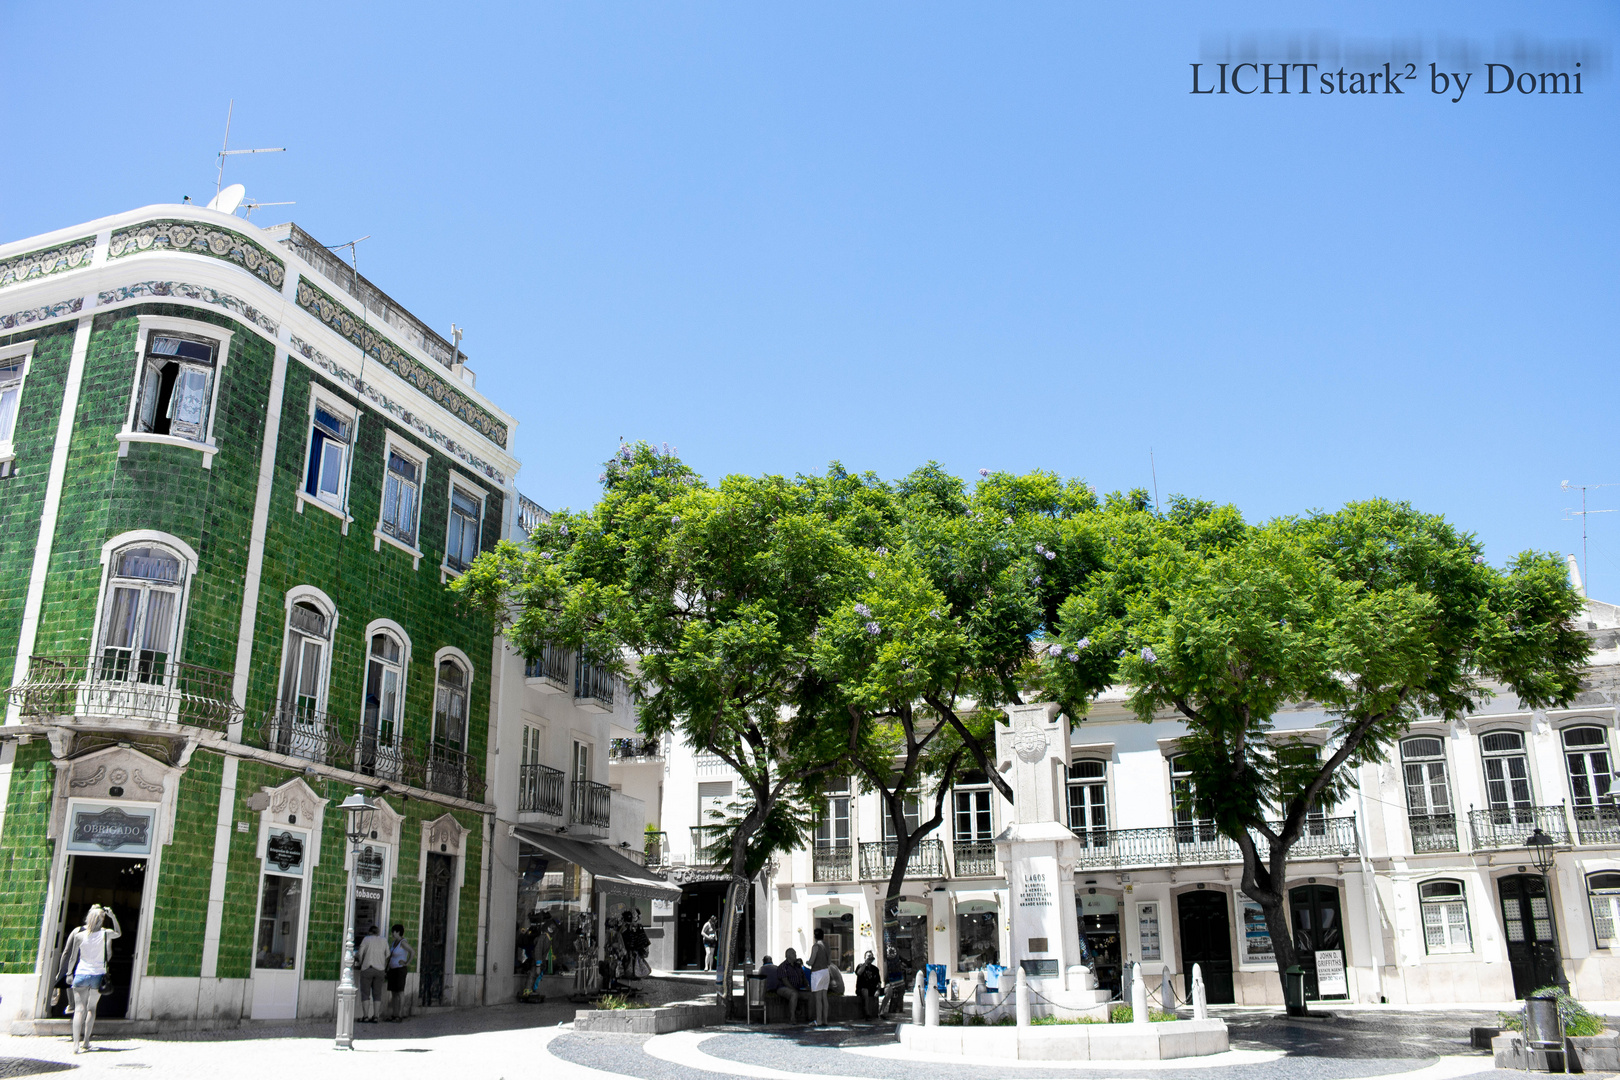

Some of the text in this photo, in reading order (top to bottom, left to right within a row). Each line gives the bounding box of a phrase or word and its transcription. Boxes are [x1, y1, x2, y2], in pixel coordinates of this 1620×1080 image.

[83, 824, 140, 836] OBRIGADO
[1024, 873, 1046, 882] LAGOS
[356, 889, 381, 900] tobacco
[1319, 952, 1333, 960] JOHN
[1317, 959, 1342, 967] GRIFFITHS
